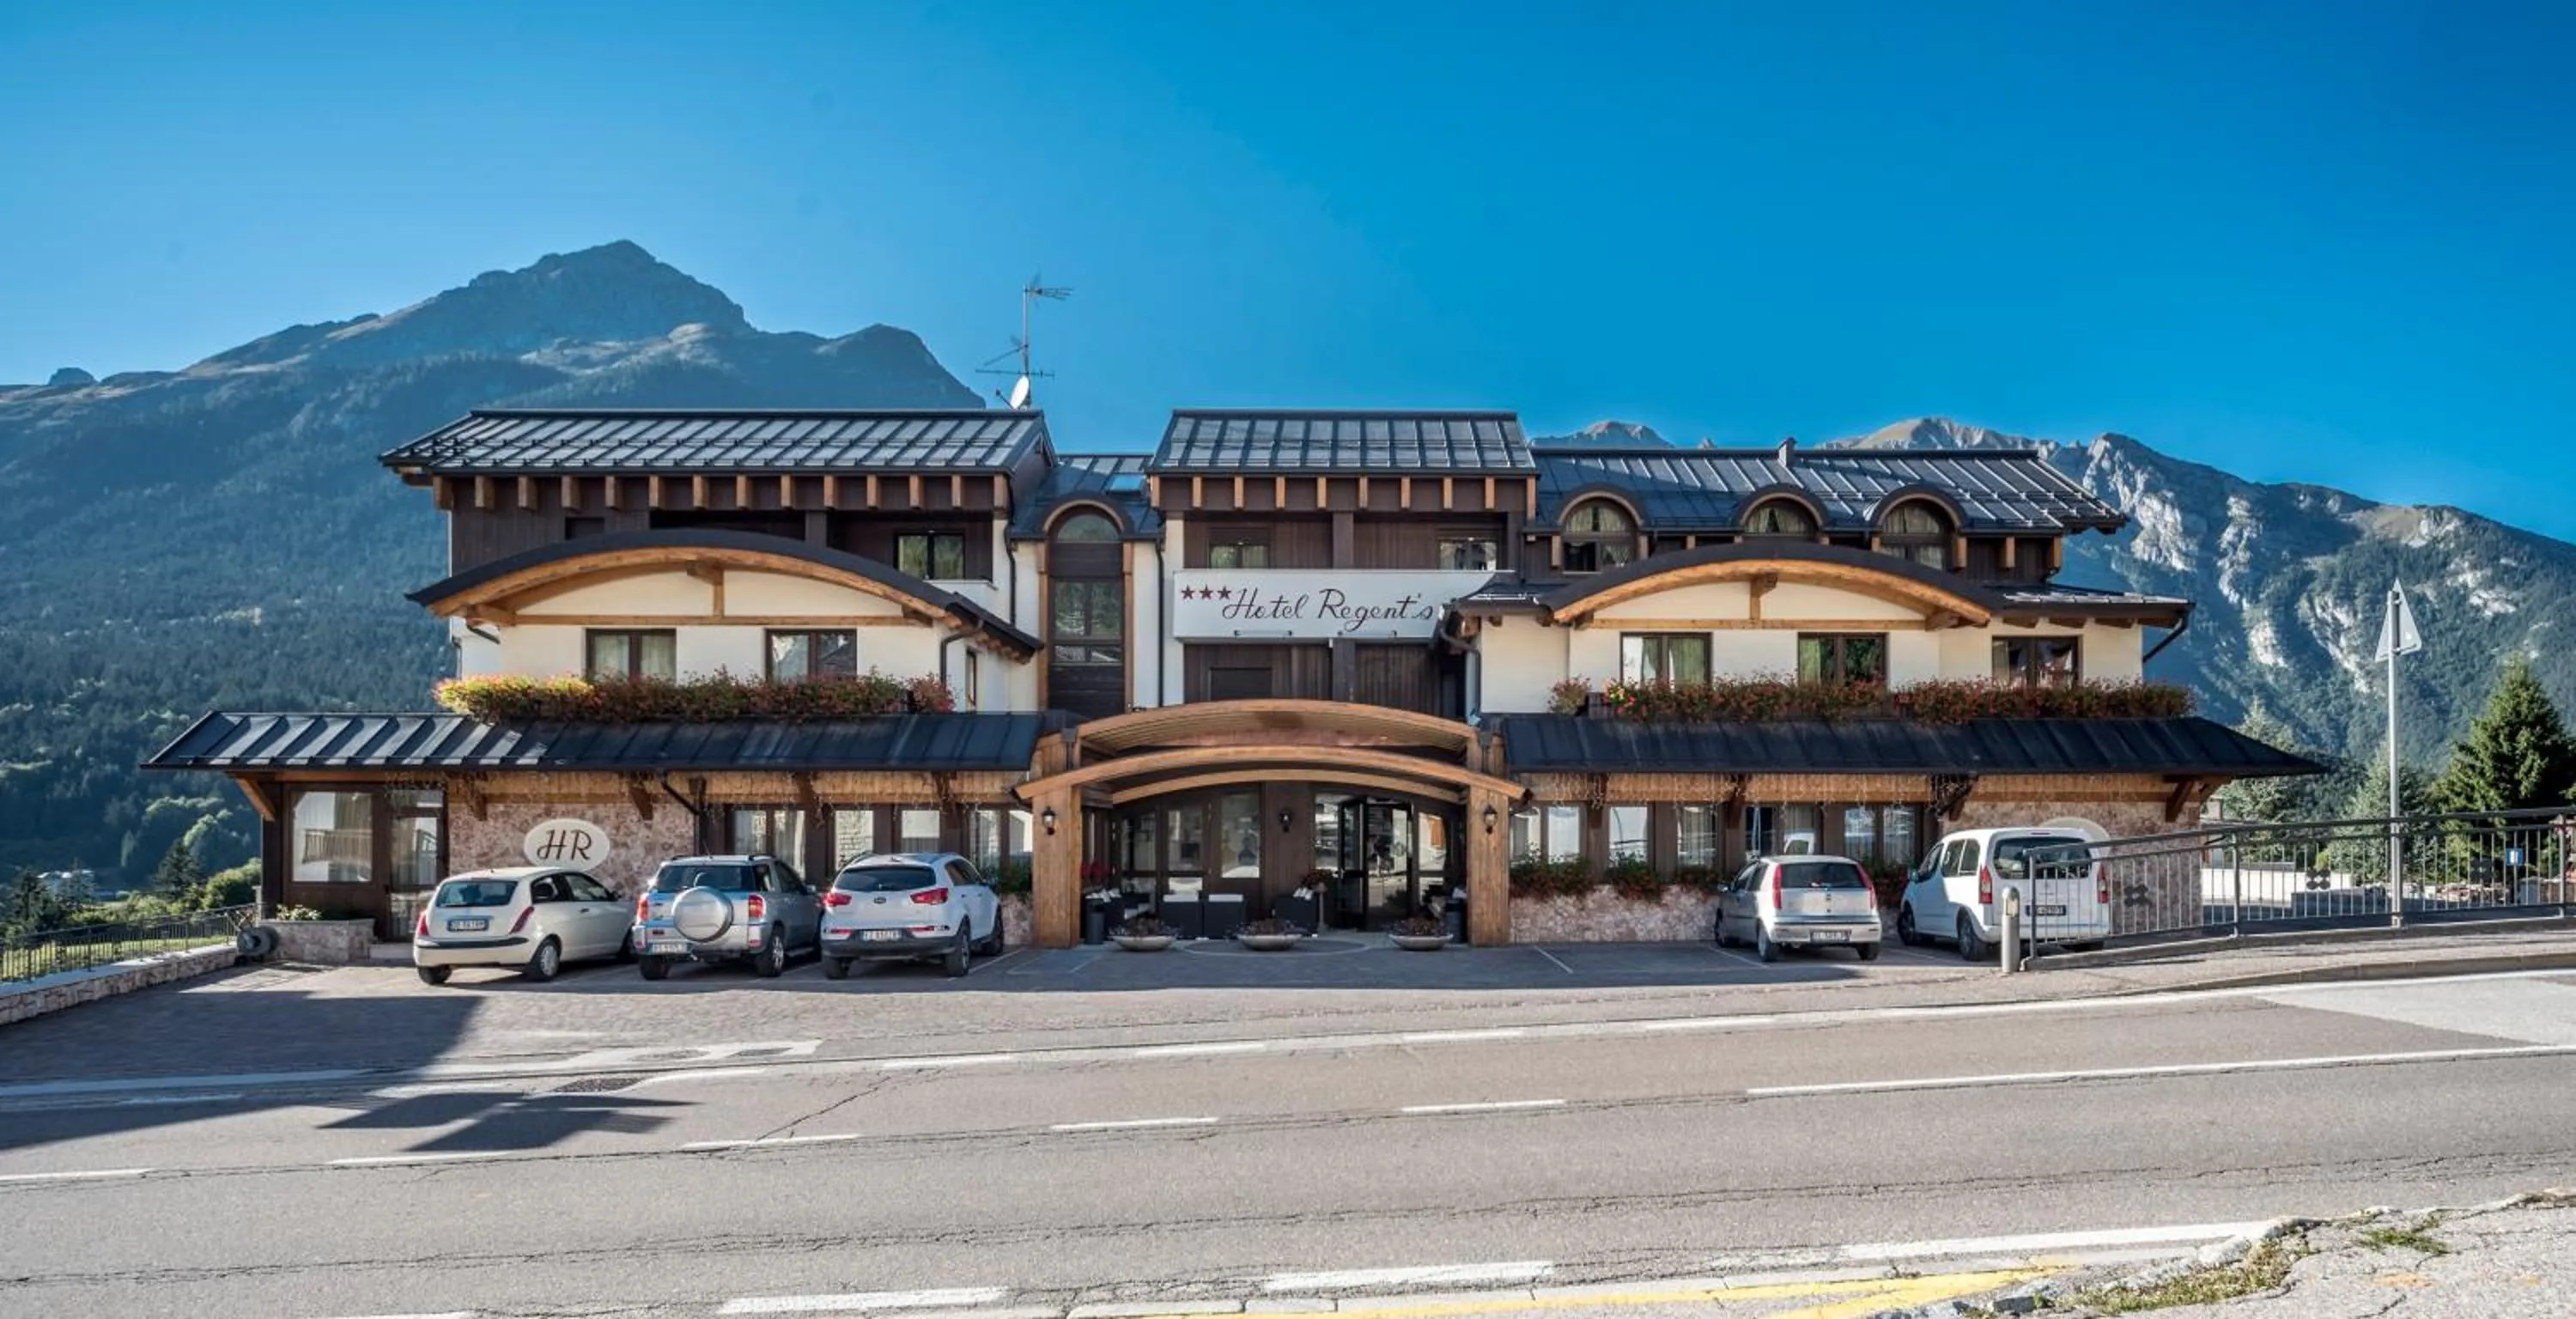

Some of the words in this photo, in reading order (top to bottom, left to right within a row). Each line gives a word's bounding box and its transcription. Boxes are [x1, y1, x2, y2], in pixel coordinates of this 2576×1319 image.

[1222, 587, 1309, 619] Hotel
[1318, 588, 1433, 632] Regent's
[537, 829, 592, 860] HR
